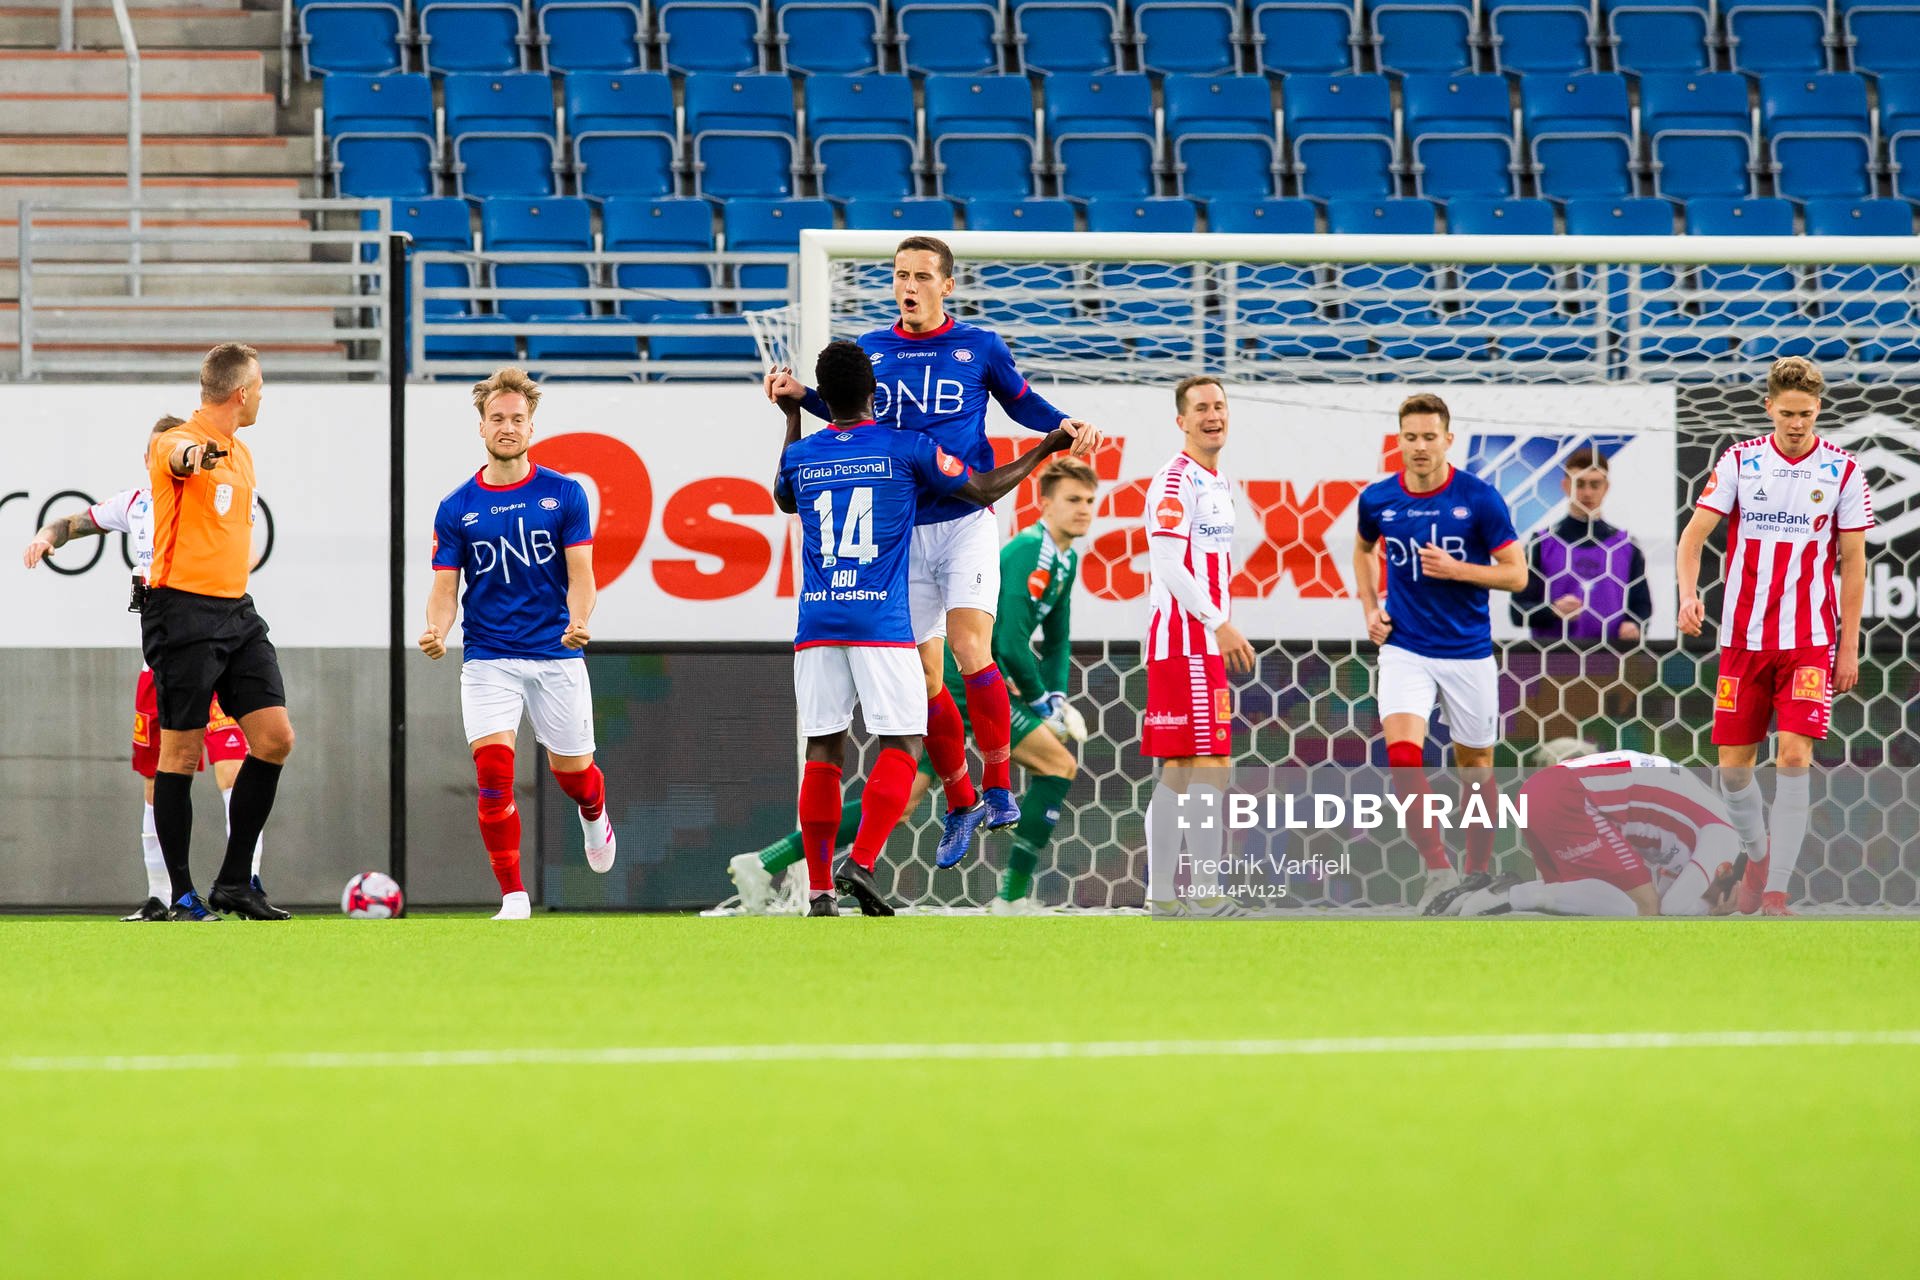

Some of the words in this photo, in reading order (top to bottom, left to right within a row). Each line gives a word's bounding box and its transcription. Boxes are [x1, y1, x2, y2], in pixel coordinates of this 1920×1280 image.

[873, 364, 964, 428] DNB
[802, 467, 832, 480] Grata
[834, 461, 885, 476] Personal
[813, 486, 879, 567] 14
[1756, 524, 1782, 533] NORD
[1783, 526, 1811, 535] NORGE
[471, 516, 557, 584] DNB
[831, 569, 858, 589] ABU
[976, 573, 982, 584] 6
[803, 589, 827, 603] mot
